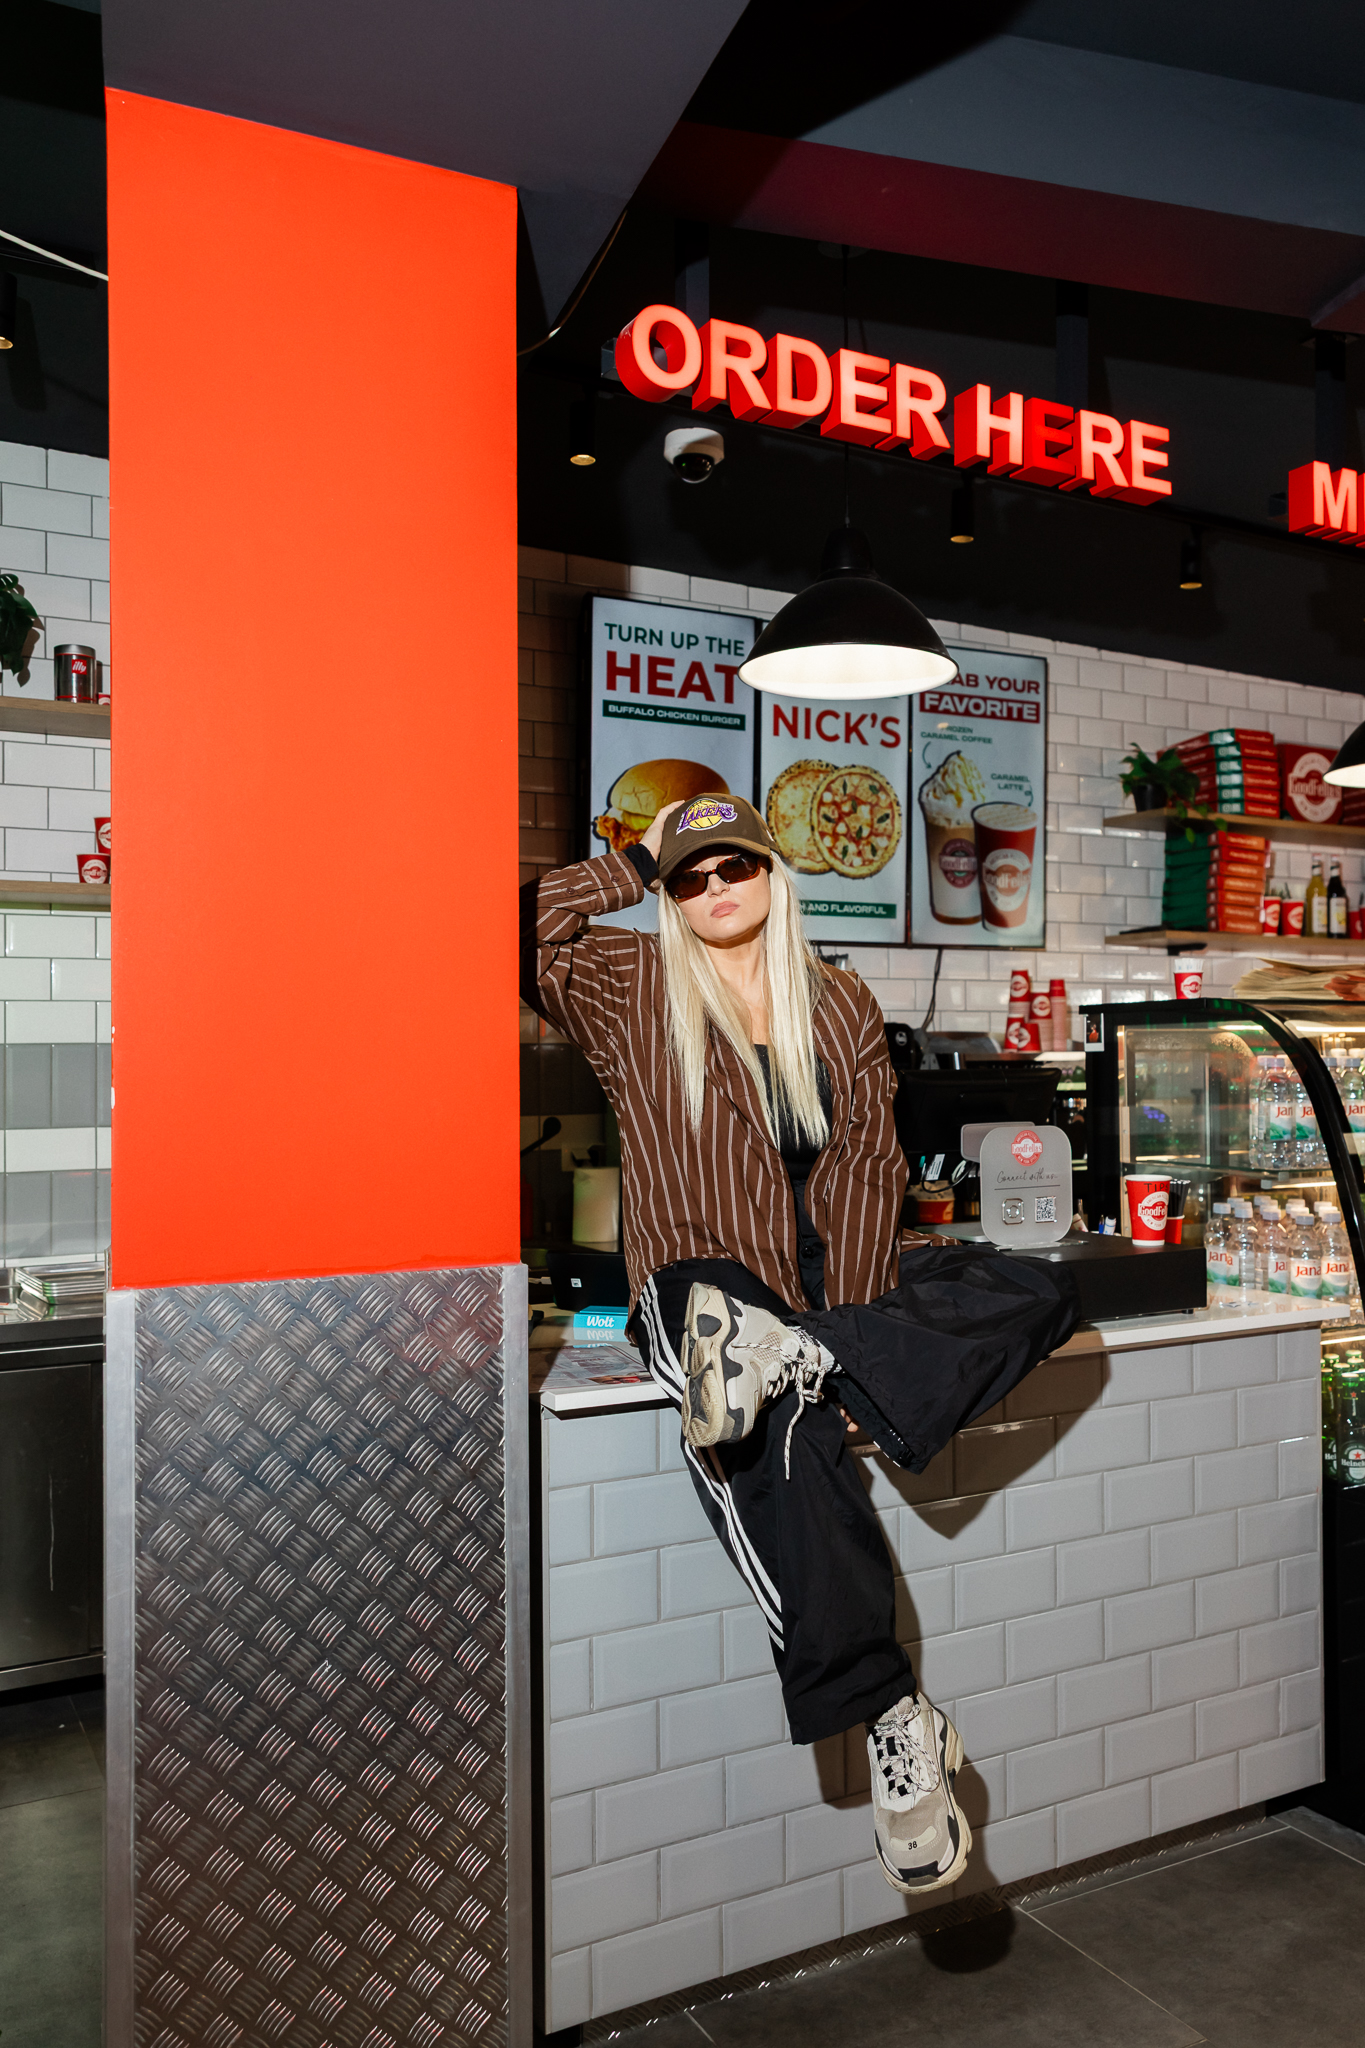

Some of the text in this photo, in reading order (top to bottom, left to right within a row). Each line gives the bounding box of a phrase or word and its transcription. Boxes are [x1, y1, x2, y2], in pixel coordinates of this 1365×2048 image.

[615, 304, 1172, 505] ORDER HERE
[1288, 460, 1365, 550] M
[604, 622, 745, 657] TURN UP THE
[72, 661, 87, 673] illy
[606, 650, 739, 704] HEAT
[945, 673, 1040, 694] AB YOUR
[924, 692, 1037, 720] FAVORITE
[608, 704, 741, 726] BUFFALO CHICKEN BURGER
[773, 703, 902, 749] NICK'S
[942, 725, 973, 734] ROZEN
[920, 731, 993, 744] CARAMEL COFFEE
[990, 773, 1031, 783] CARAMEL
[997, 783, 1024, 791] LATTE
[677, 805, 738, 832] LAKERS
[807, 903, 829, 912] AND
[830, 903, 887, 915] FLAVORFUL
[1144, 1183, 1169, 1193] TIPS
[586, 1315, 615, 1328] Wolt
[907, 1840, 918, 1850] 38
